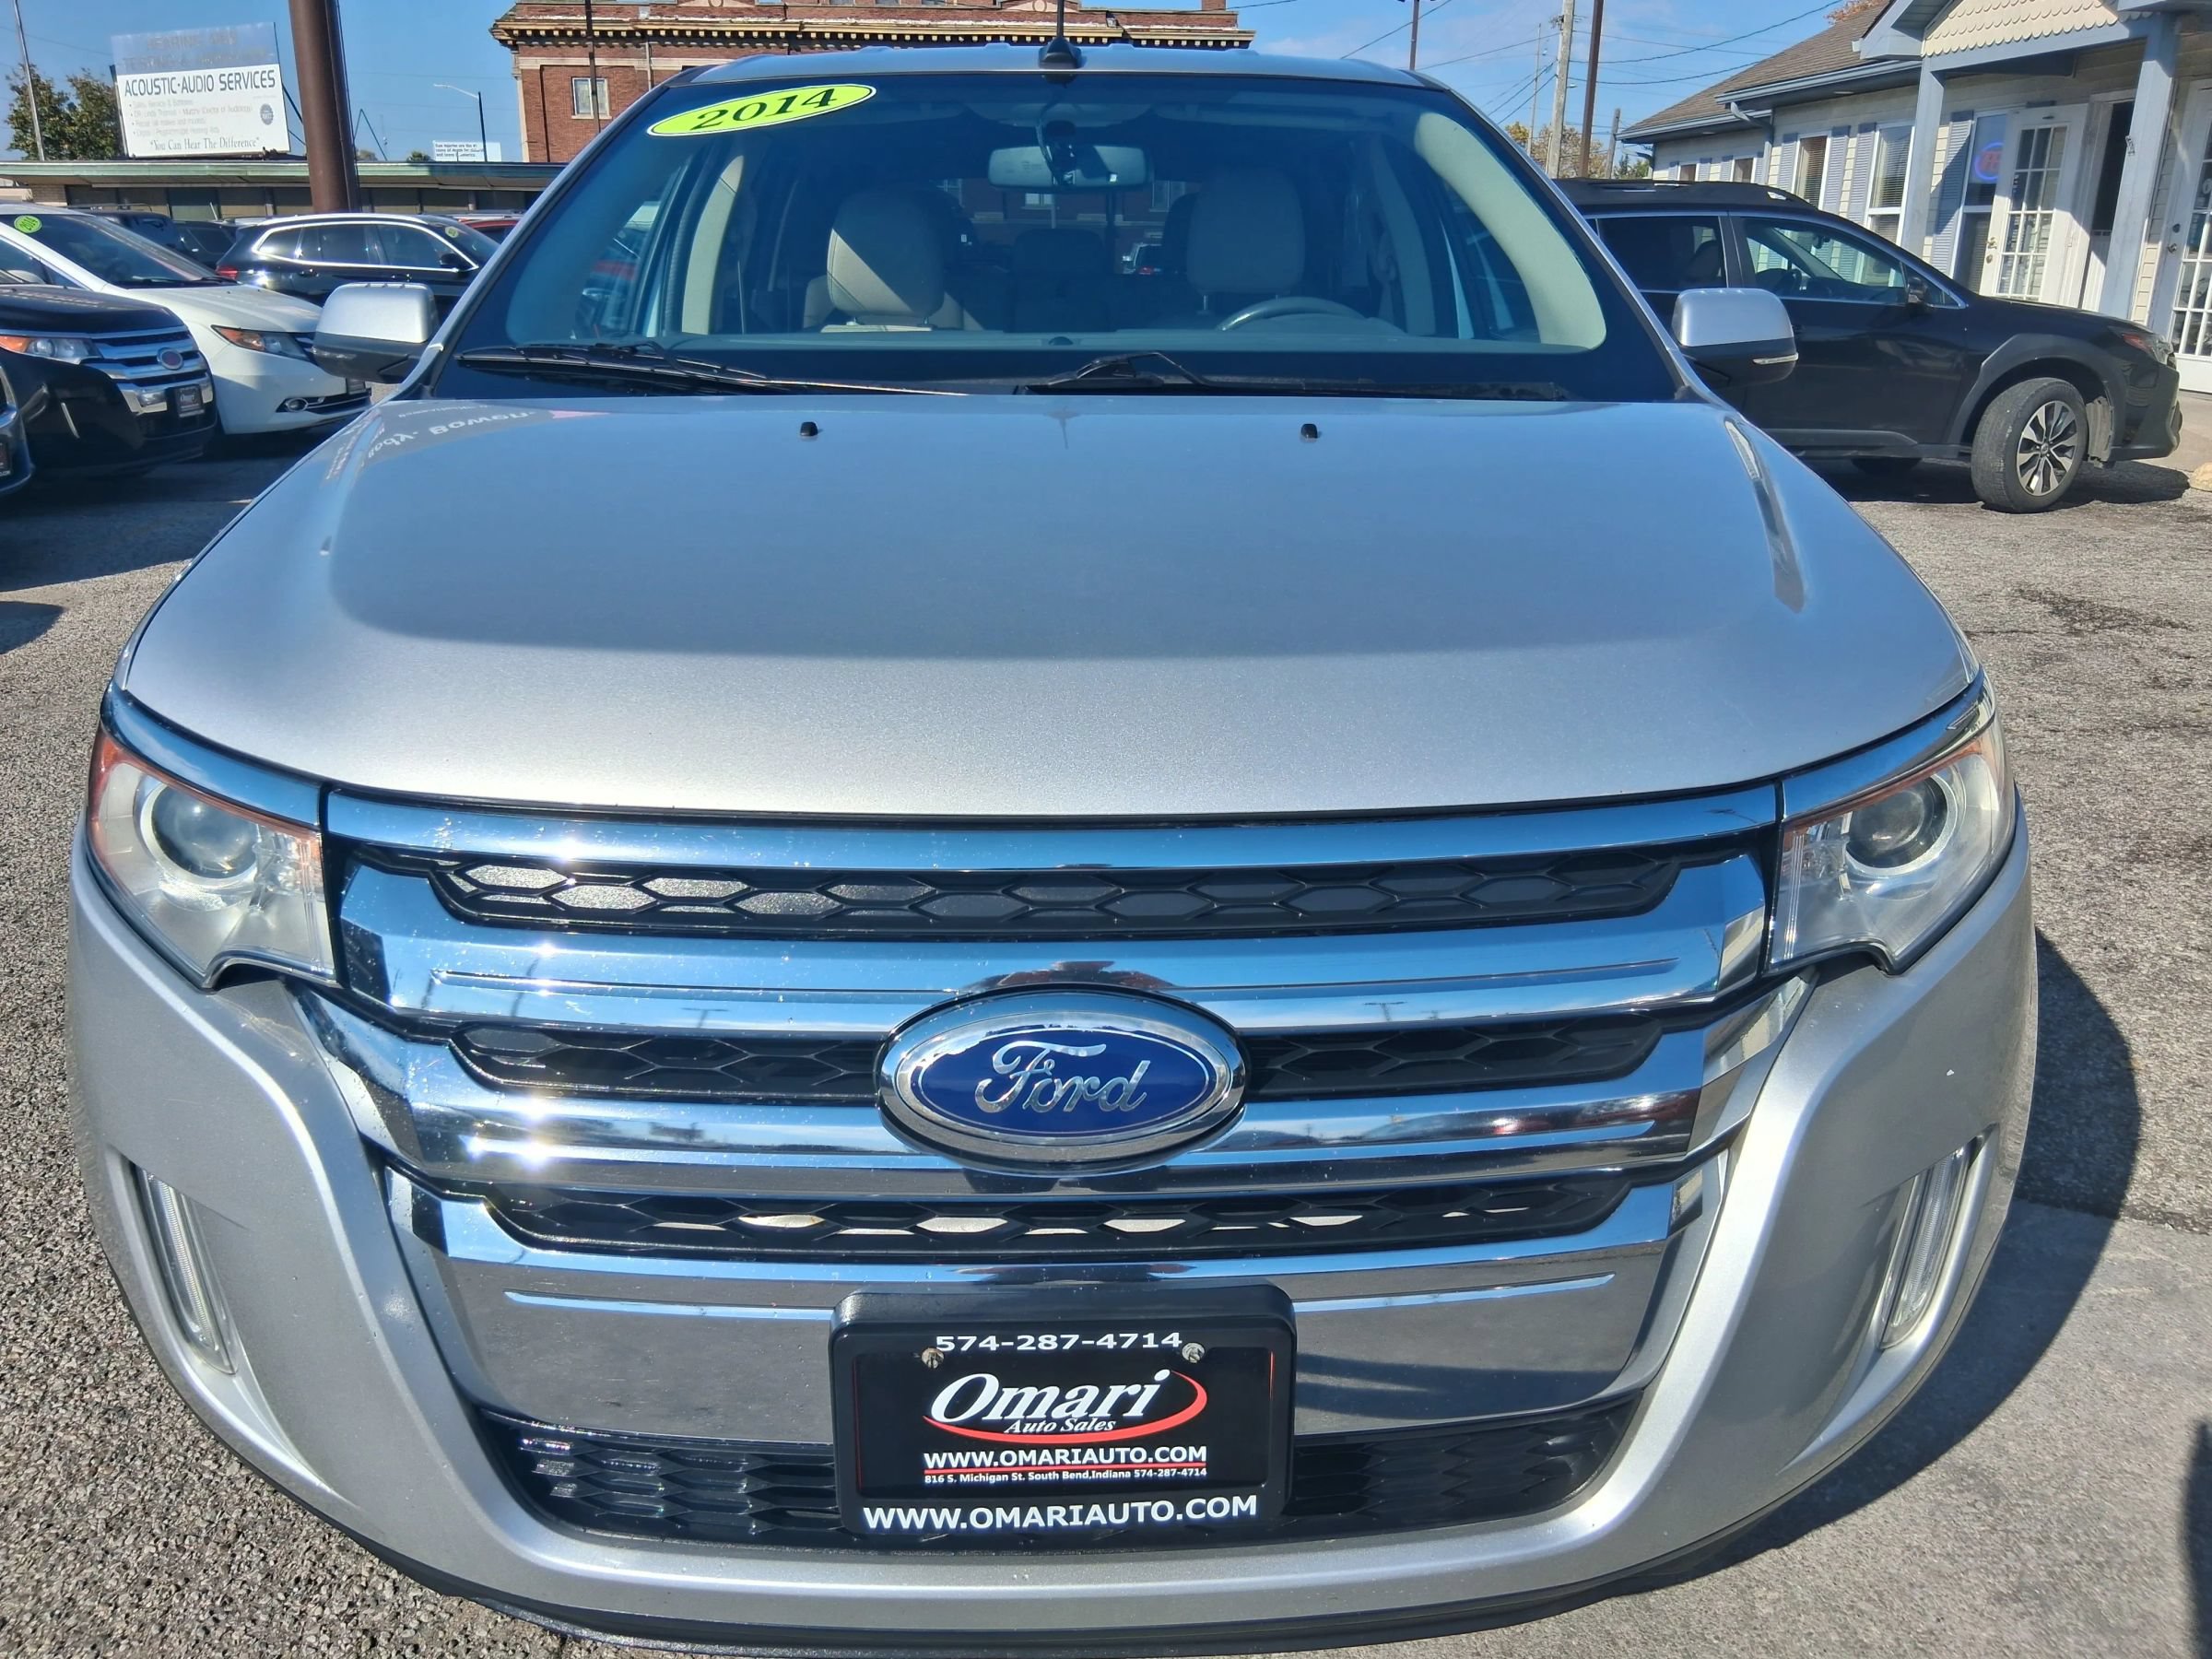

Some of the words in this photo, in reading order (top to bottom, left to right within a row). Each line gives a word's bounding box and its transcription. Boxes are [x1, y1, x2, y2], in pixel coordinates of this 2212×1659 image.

[218, 69, 276, 91] SERVICES
[690, 88, 838, 131] 2014
[168, 139, 182, 150] Can
[184, 137, 201, 149] Hear
[204, 137, 217, 149] The
[974, 1039, 1151, 1113] Ford
[935, 1332, 1182, 1352] 574-287-4714
[930, 1369, 1171, 1424] Omari
[1003, 1419, 1057, 1434] Auto
[1060, 1417, 1117, 1431] Sales
[923, 1445, 1207, 1469] WWW.OMARIAUTO.COM
[924, 1475, 945, 1484] 816
[959, 1473, 1009, 1484] Michigan
[1011, 1472, 1026, 1481] St.
[1028, 1471, 1060, 1481] South
[1134, 1467, 1207, 1478] 574-287-4714
[863, 1494, 1258, 1531] WWW.OMARIAUTO.COM
